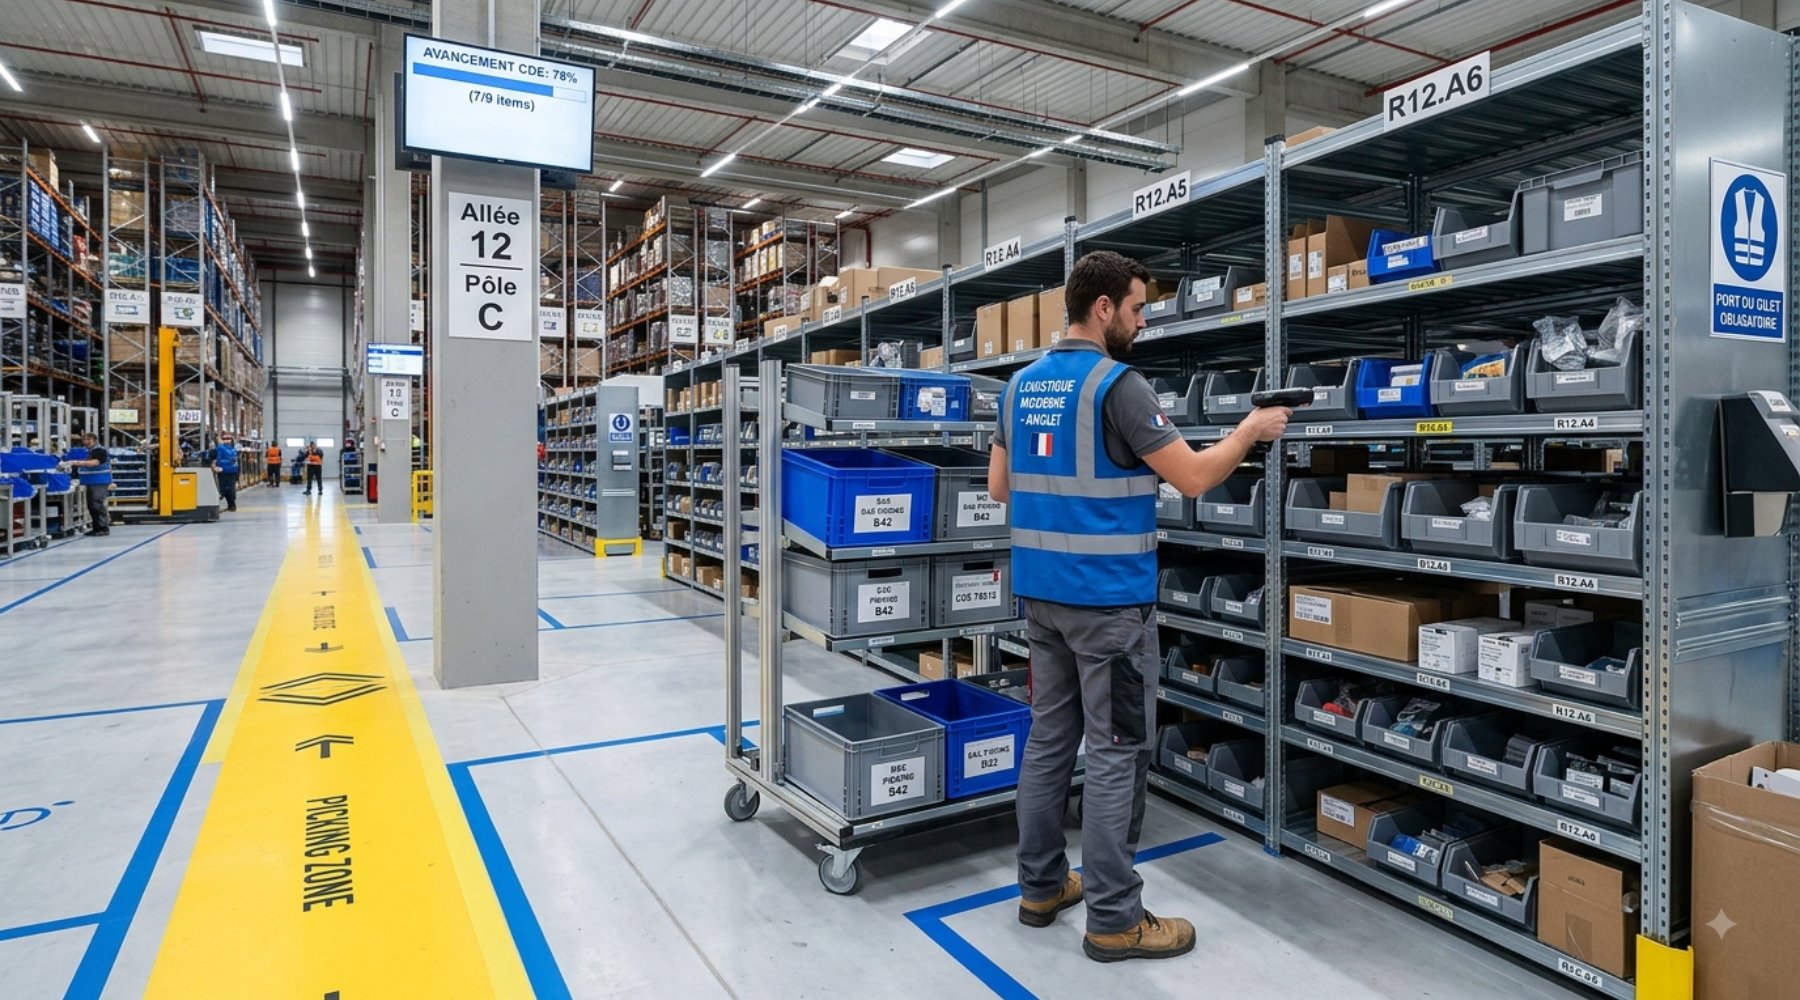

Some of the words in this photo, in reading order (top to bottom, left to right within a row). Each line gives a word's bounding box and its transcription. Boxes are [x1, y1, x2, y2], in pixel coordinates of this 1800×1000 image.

[423, 47, 515, 72] AVANCEMENT
[518, 63, 549, 78] CDE:
[552, 69, 578, 84] 78%
[468, 89, 494, 104] (7/9
[496, 93, 535, 112] items)
[1388, 64, 1483, 122] R12.A6
[1135, 178, 1188, 214] R12.A5
[460, 202, 520, 226] Allée
[471, 230, 512, 260] 12
[465, 274, 517, 296] Pôle
[1716, 292, 1741, 308] PORT
[1756, 298, 1781, 313] GILET
[478, 302, 504, 331] C
[1025, 413, 1062, 426] ANGLET
[1557, 418, 1594, 429] R12.A4
[875, 605, 893, 616] B42
[304, 795, 351, 858] PICKING
[303, 857, 354, 913] ZONE
